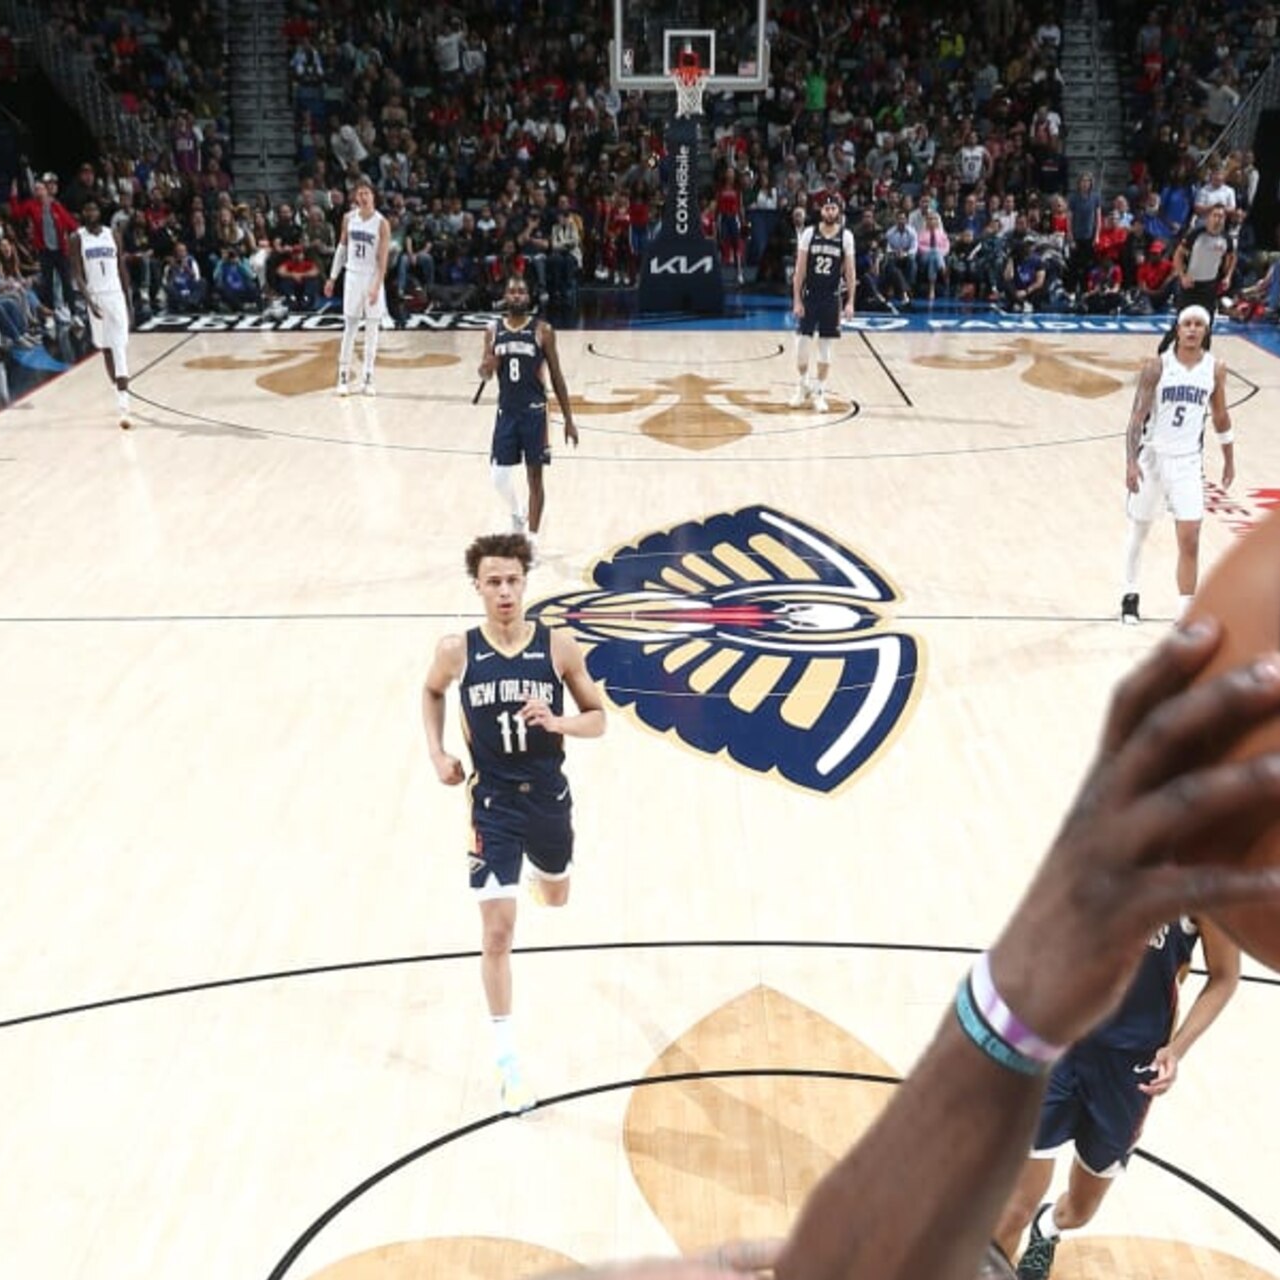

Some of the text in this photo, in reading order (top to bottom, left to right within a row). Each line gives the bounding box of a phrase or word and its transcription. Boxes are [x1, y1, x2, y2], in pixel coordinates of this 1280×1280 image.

[675, 197, 689, 235] COX
[355, 244, 367, 259] 21
[650, 255, 713, 274] KIA
[814, 256, 832, 275] 22
[509, 357, 521, 382] 8
[1161, 385, 1208, 406] MAGIC
[1172, 406, 1186, 427] 5
[468, 681, 496, 707] NEW
[497, 711, 527, 754] 11
